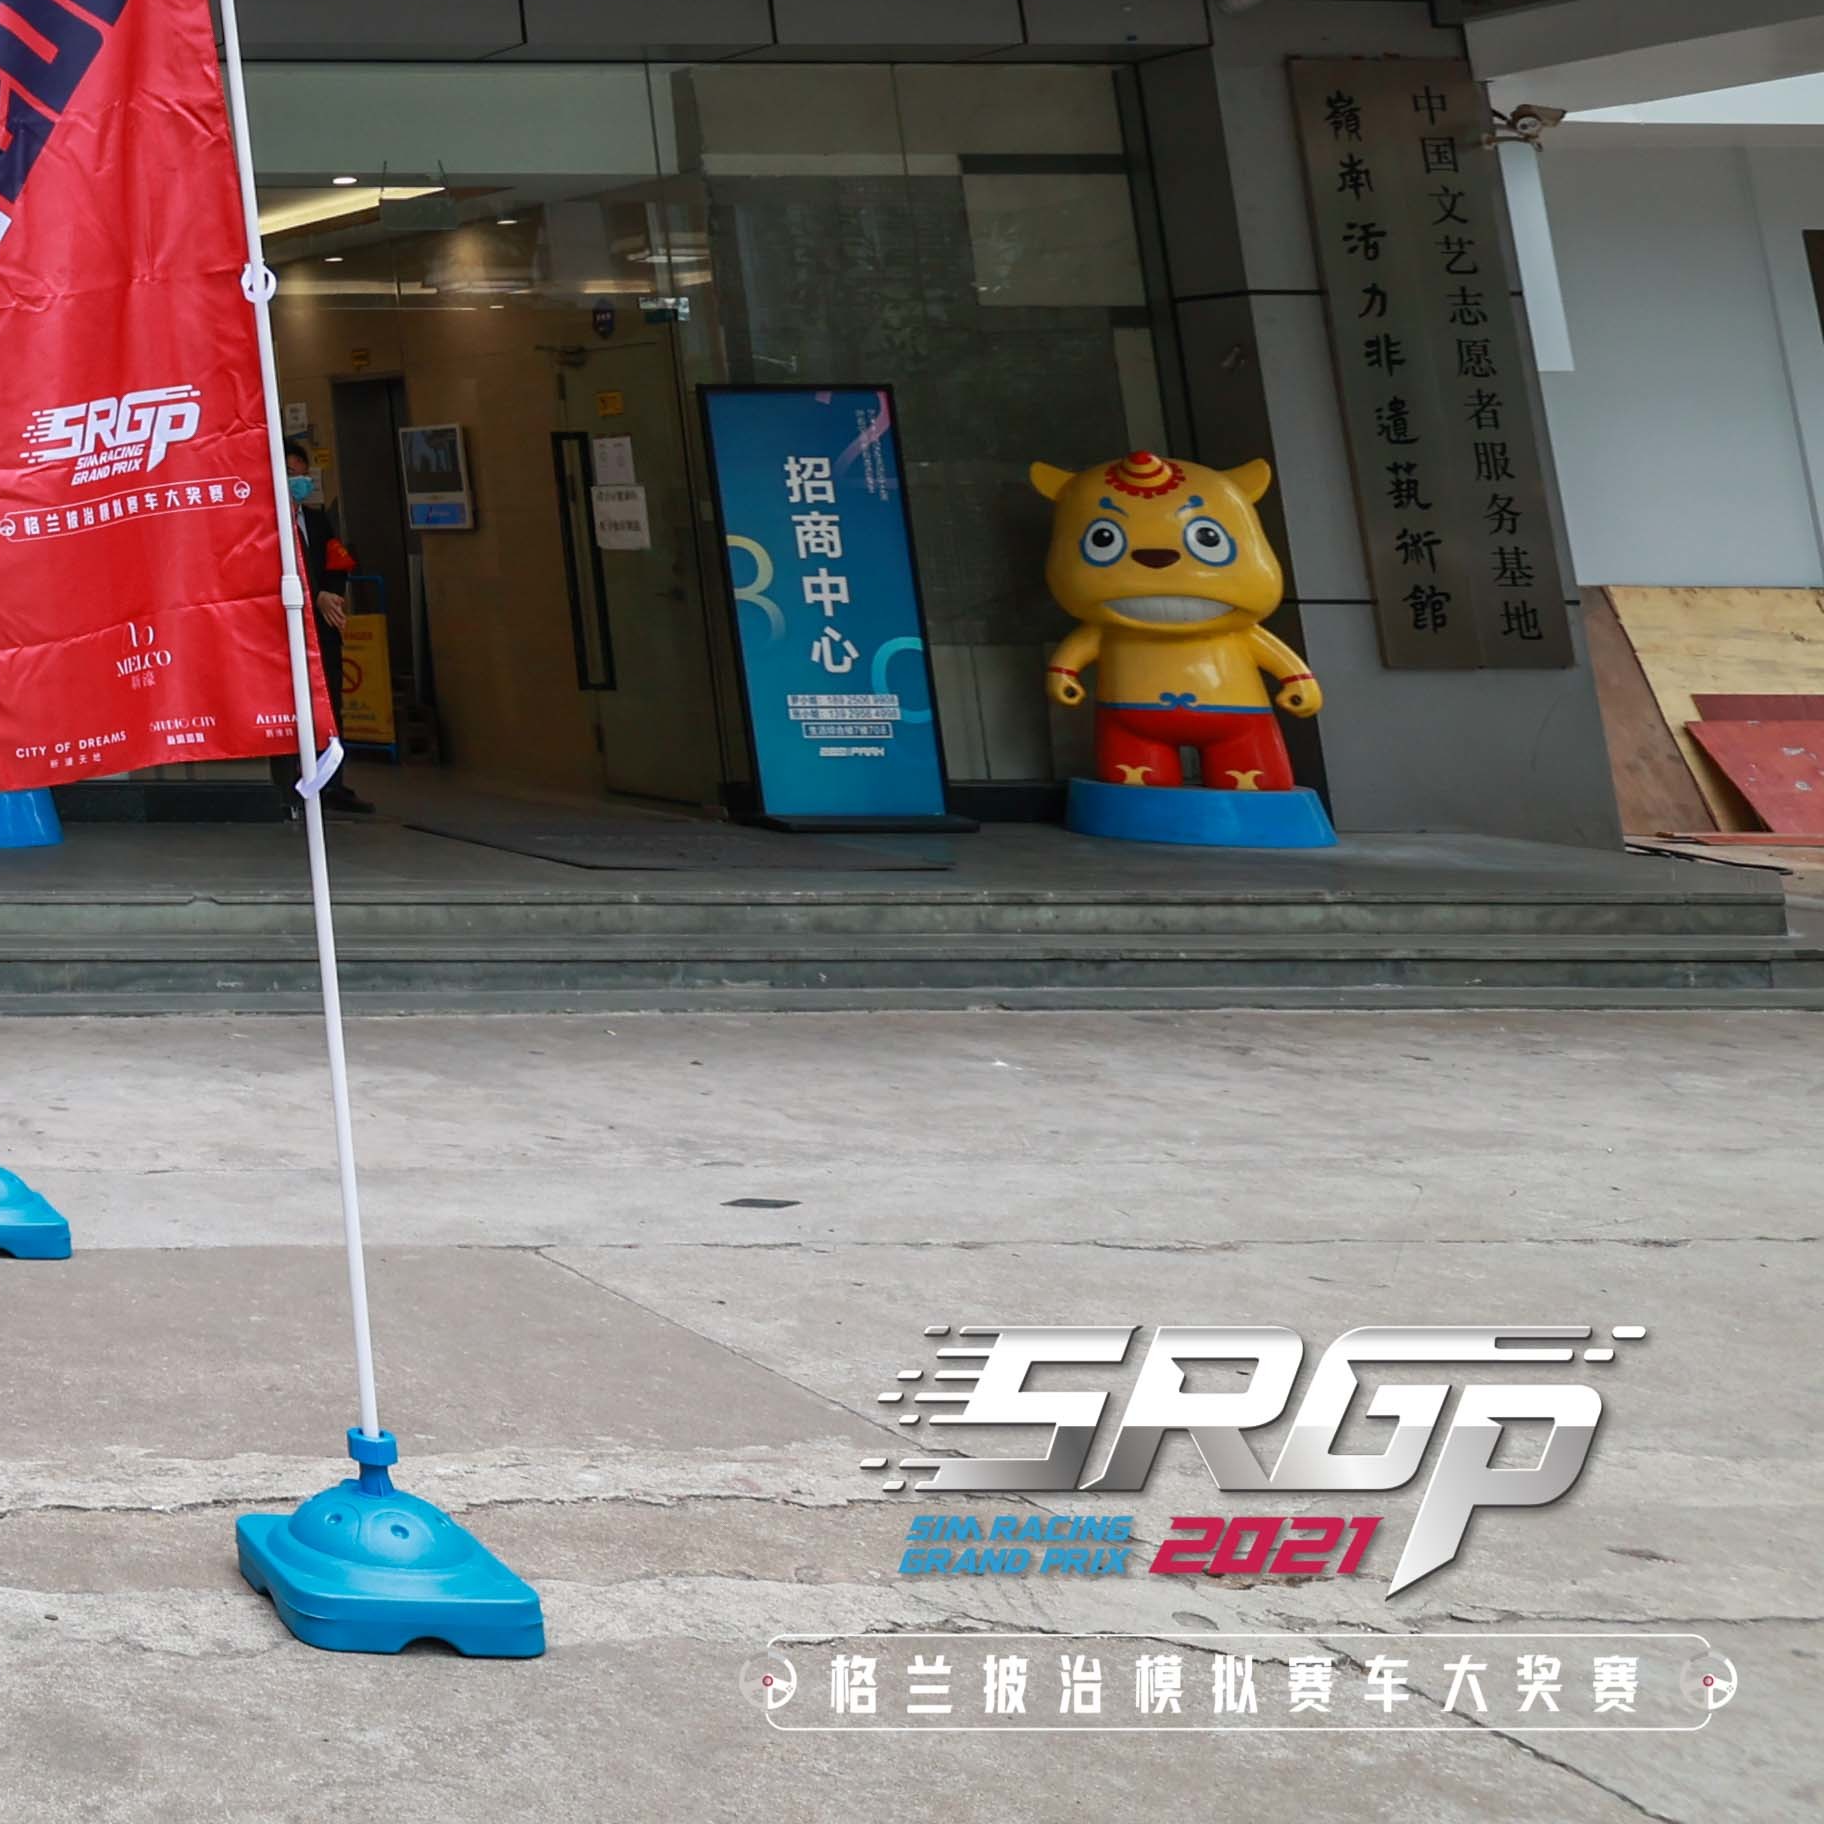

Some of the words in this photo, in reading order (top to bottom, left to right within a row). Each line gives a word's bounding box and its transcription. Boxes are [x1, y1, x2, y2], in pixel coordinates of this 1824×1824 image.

[1412, 84, 1544, 641] 中国文艺志愿者服务基地
[20, 384, 201, 473] SRGP
[75, 453, 101, 471] SIM
[99, 442, 146, 464] RACING
[71, 465, 110, 486] GRAND
[110, 457, 144, 478] PRIX
[783, 455, 861, 674] 招商中心
[115, 649, 173, 678] MELCO
[15, 745, 48, 759] CITY
[55, 741, 72, 754] OF
[78, 730, 128, 750] DREAMS
